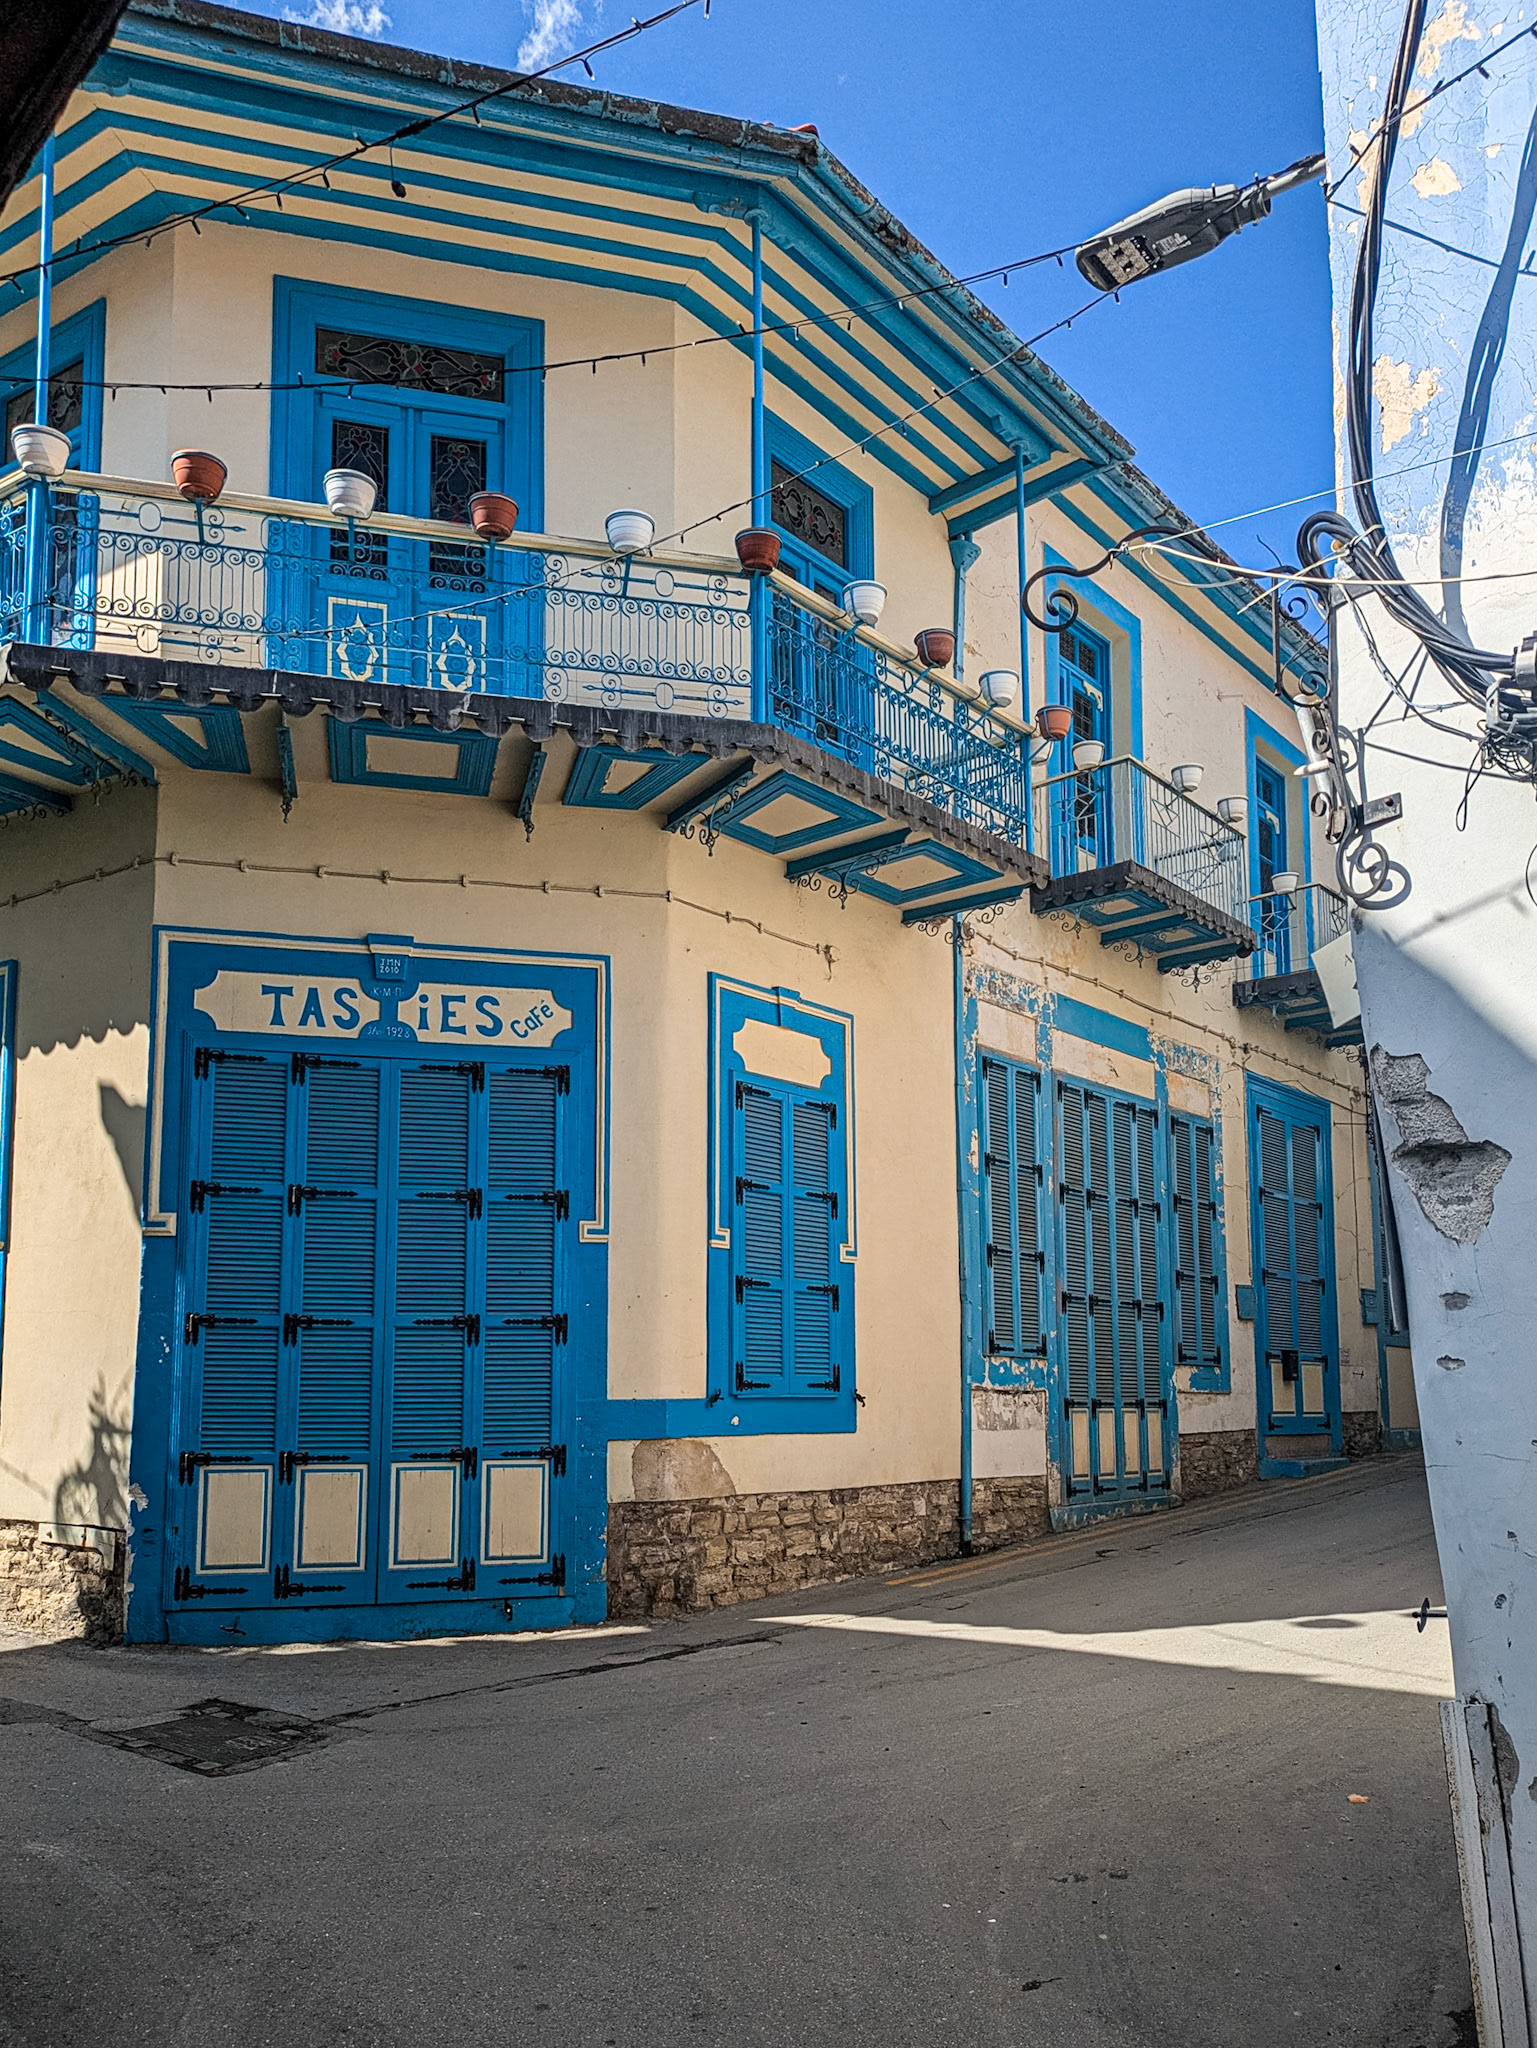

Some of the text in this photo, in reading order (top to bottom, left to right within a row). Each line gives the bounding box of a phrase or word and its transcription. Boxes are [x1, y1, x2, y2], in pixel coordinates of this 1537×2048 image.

[379, 966, 400, 974] 2010
[261, 984, 362, 1030] TAS
[386, 1027, 411, 1038] 1928
